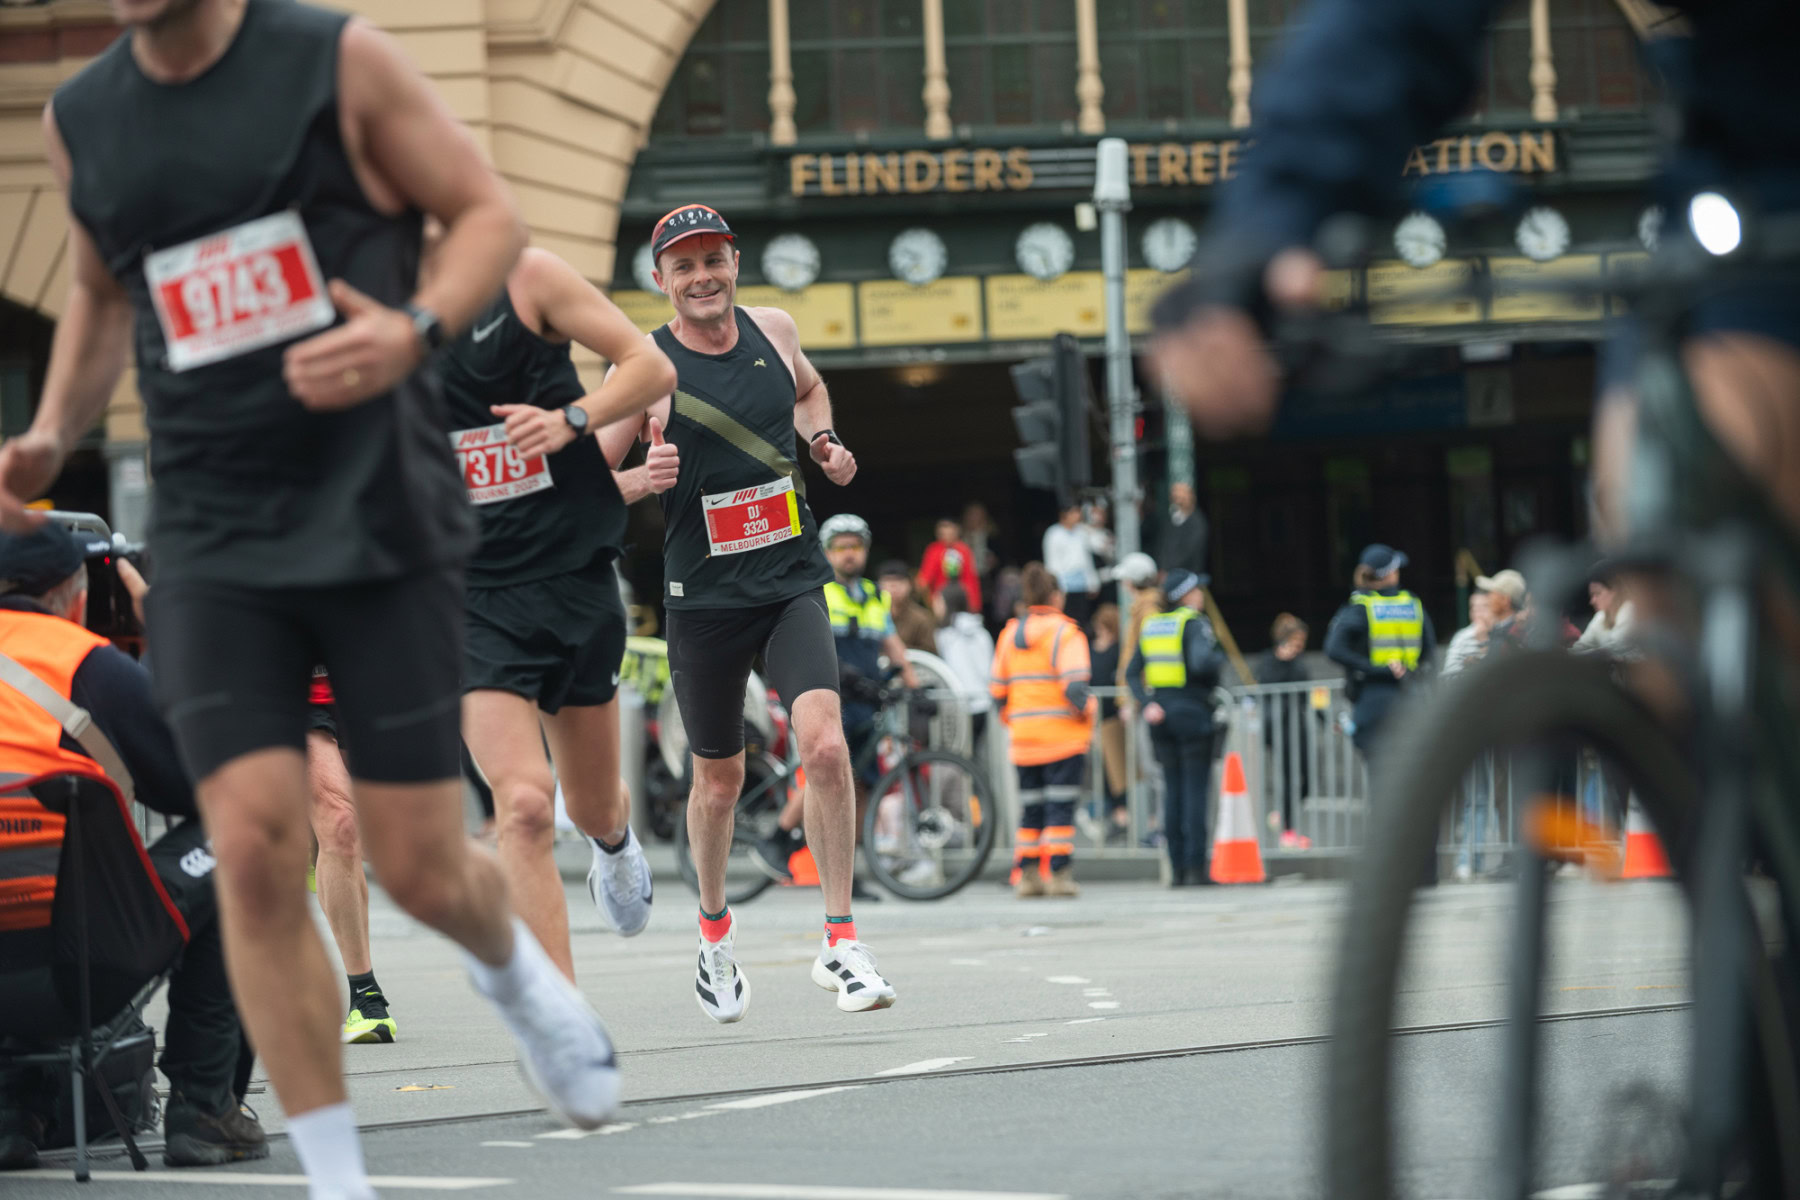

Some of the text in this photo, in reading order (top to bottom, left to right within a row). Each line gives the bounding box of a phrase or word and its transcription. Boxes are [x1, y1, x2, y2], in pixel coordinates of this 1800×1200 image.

[791, 130, 1556, 196] FLINDERS TREE ATION
[181, 254, 291, 330] 9743
[747, 504, 760, 520] DJ
[743, 518, 769, 536] 3320
[720, 528, 793, 553] MELBOURNE 2025
